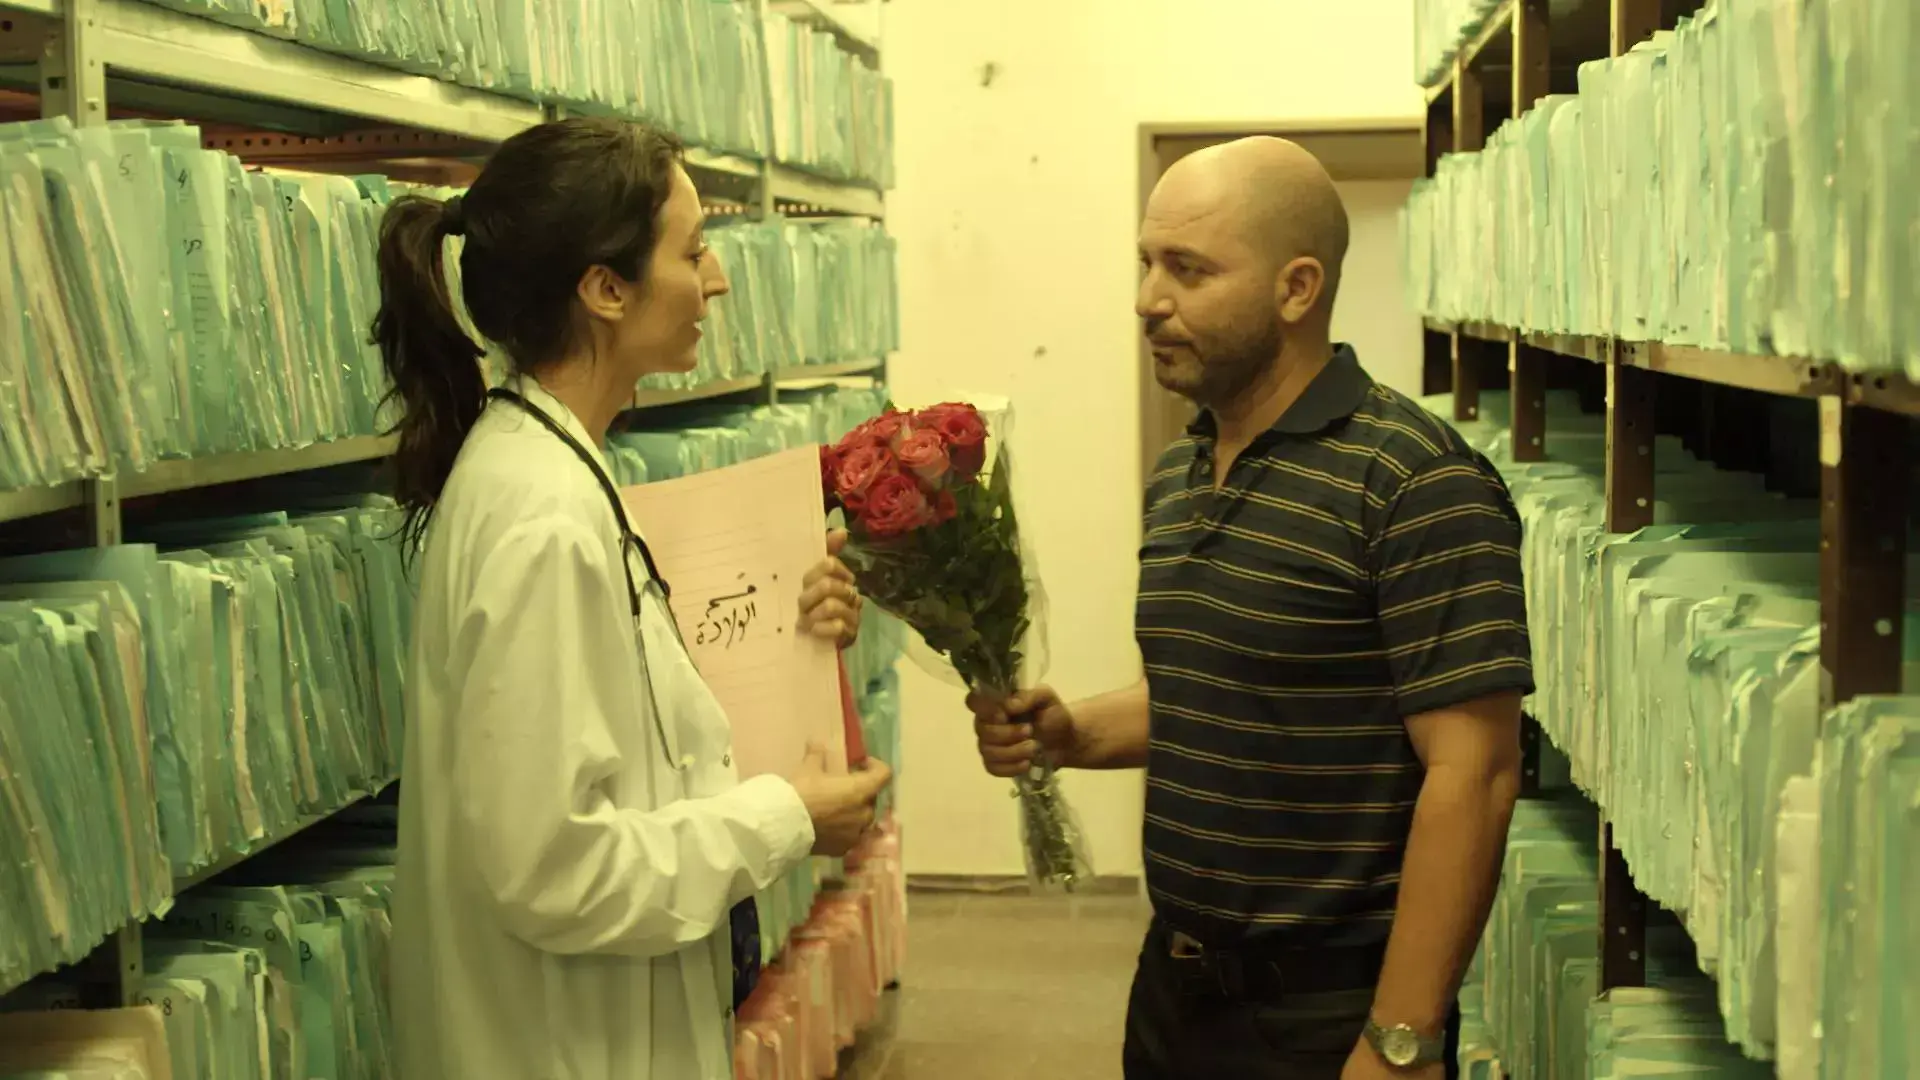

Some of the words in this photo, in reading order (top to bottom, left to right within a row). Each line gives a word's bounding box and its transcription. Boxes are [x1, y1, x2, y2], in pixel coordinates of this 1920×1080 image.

[177, 168, 189, 189] 4
[705, 571, 757, 619] قسم
[696, 600, 757, 651] الولادة
